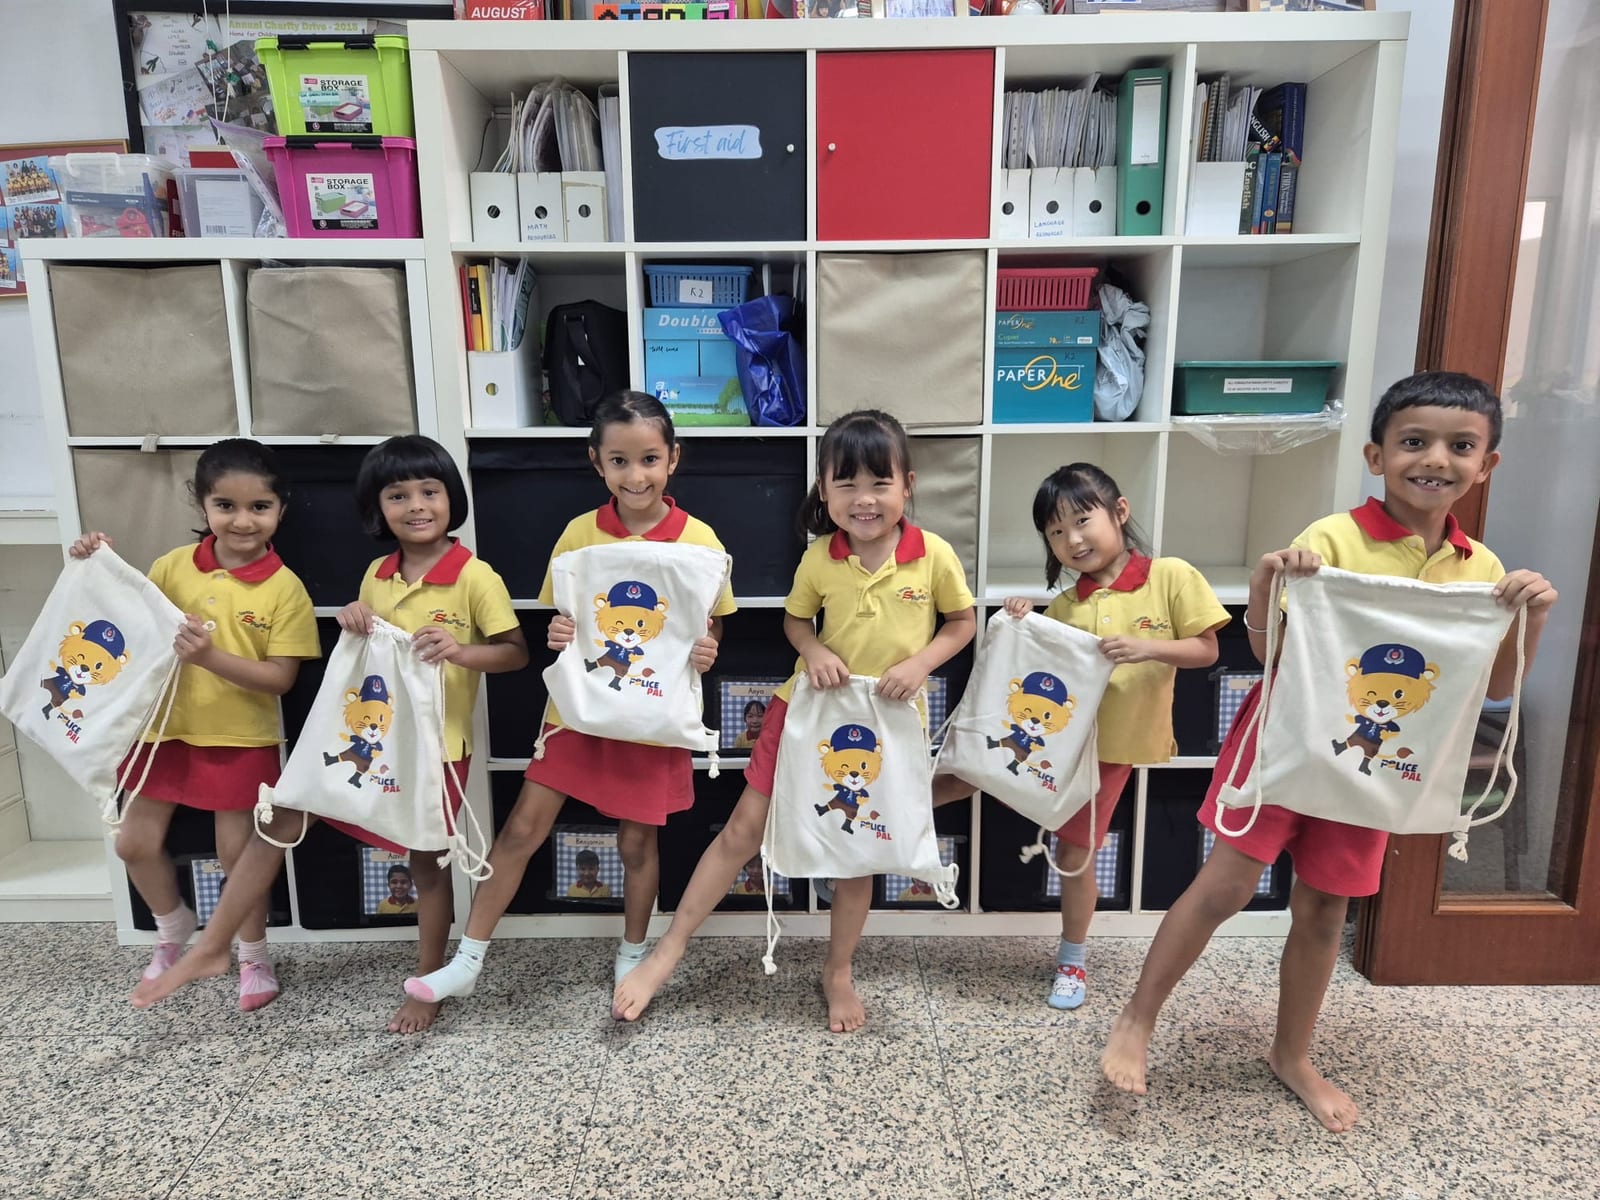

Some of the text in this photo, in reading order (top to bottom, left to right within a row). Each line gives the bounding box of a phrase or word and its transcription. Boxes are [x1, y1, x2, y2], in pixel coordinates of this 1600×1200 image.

[471, 7, 527, 19] AUGUST
[229, 20, 262, 30] Annual
[264, 20, 299, 31] Charity
[302, 22, 328, 31] Drive
[320, 79, 364, 87] STORAGE
[1250, 115, 1271, 142] NGLISH
[666, 129, 746, 154] First aid
[1242, 171, 1253, 209] English
[527, 223, 548, 231] MATH
[658, 314, 717, 328] Double
[629, 678, 660, 689] POLICE
[647, 688, 663, 697] PAL
[57, 713, 81, 734] POLICE
[66, 730, 80, 744] PAL
[1380, 759, 1418, 772] POLICE
[370, 775, 395, 786] POLICE
[1027, 766, 1055, 784] POLICE
[1402, 771, 1422, 782] PAL
[1041, 781, 1057, 793] PAL
[860, 821, 886, 832] POLICE
[876, 831, 892, 841] PAL
